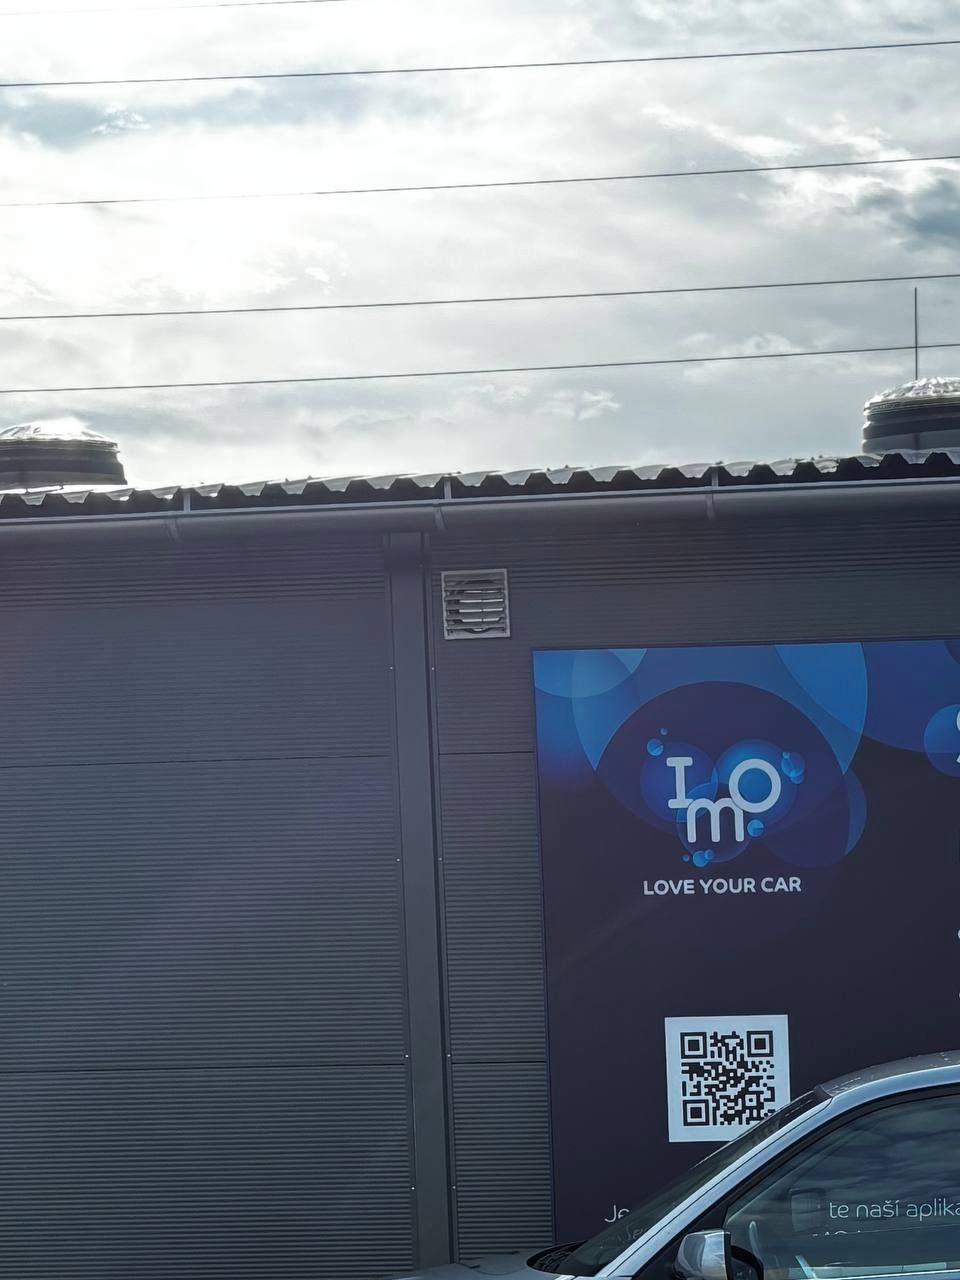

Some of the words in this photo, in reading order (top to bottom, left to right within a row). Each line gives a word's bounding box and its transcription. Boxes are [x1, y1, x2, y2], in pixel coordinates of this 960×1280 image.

[643, 879, 695, 895] LOVE
[699, 877, 756, 894] YOUR
[761, 876, 802, 893] CAR
